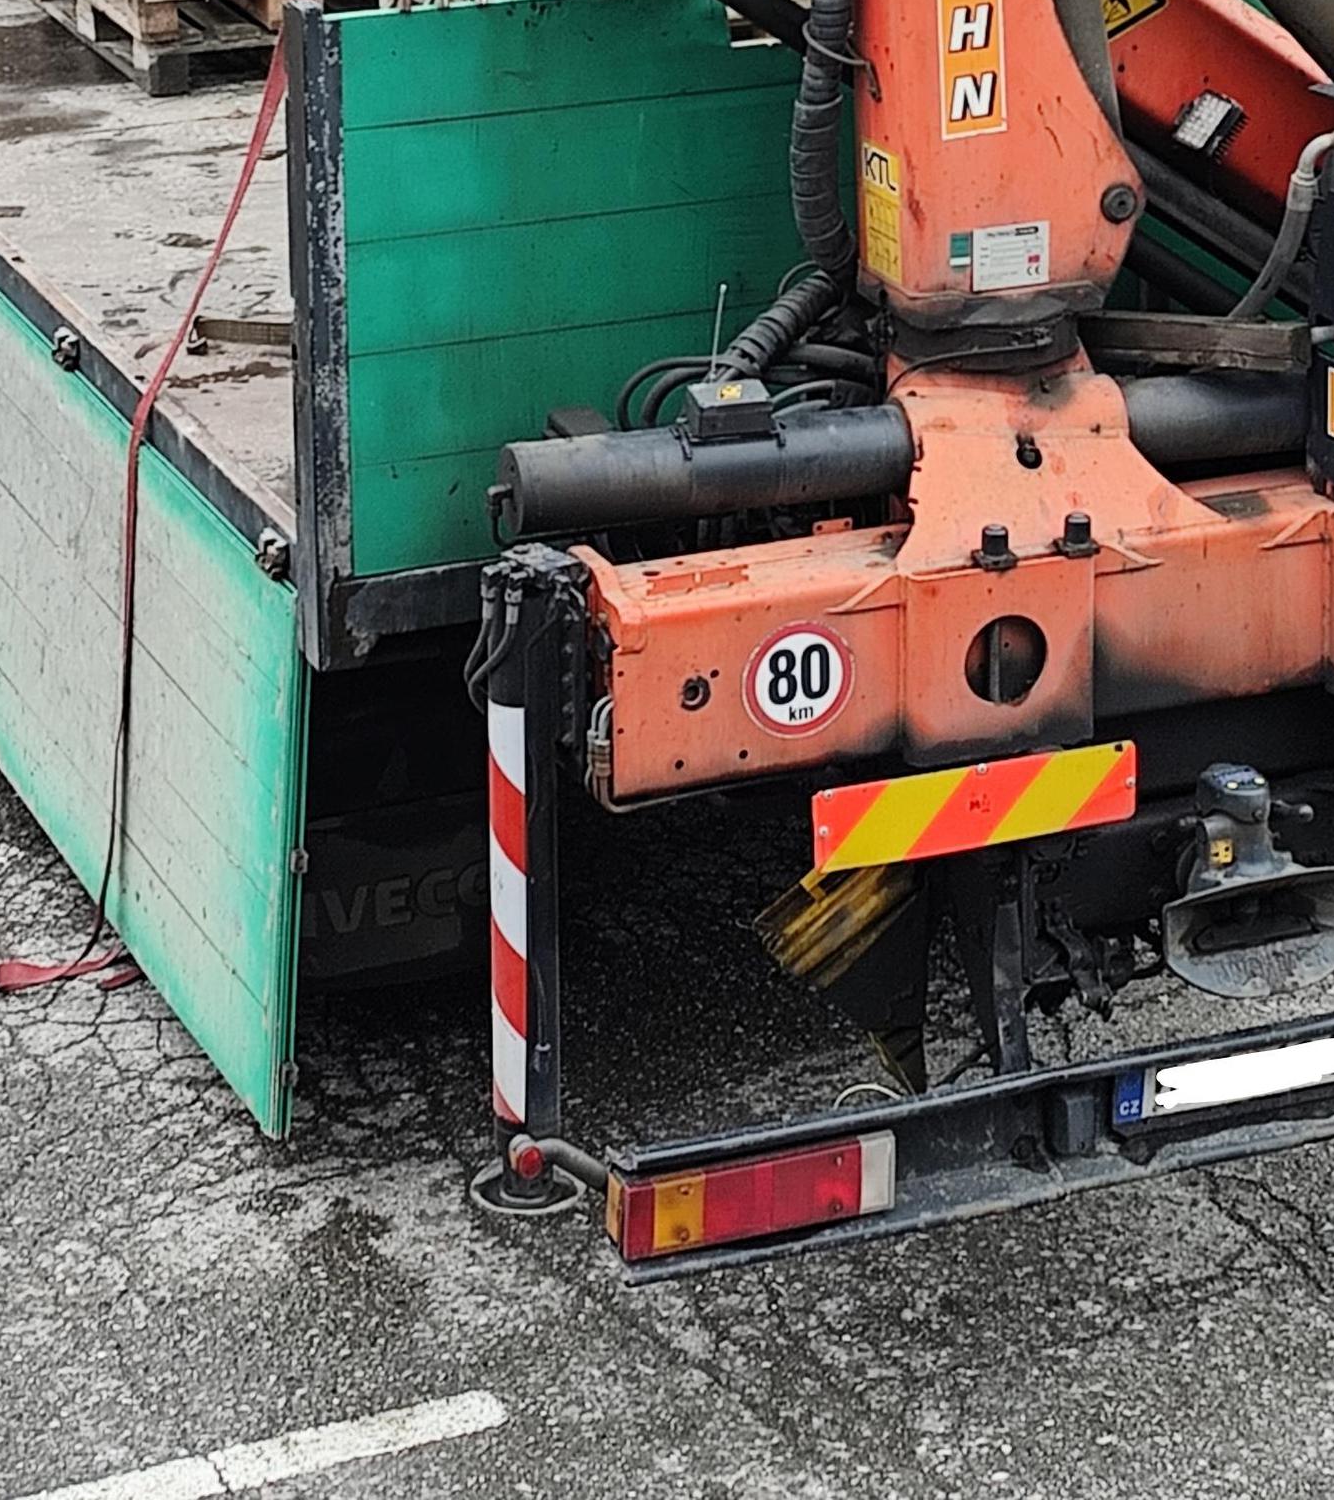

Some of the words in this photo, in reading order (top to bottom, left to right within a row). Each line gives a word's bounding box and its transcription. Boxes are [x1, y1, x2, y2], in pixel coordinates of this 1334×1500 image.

[768, 643, 830, 705] 80
[789, 706, 813, 721] km
[1119, 1099, 1140, 1116] CZ
